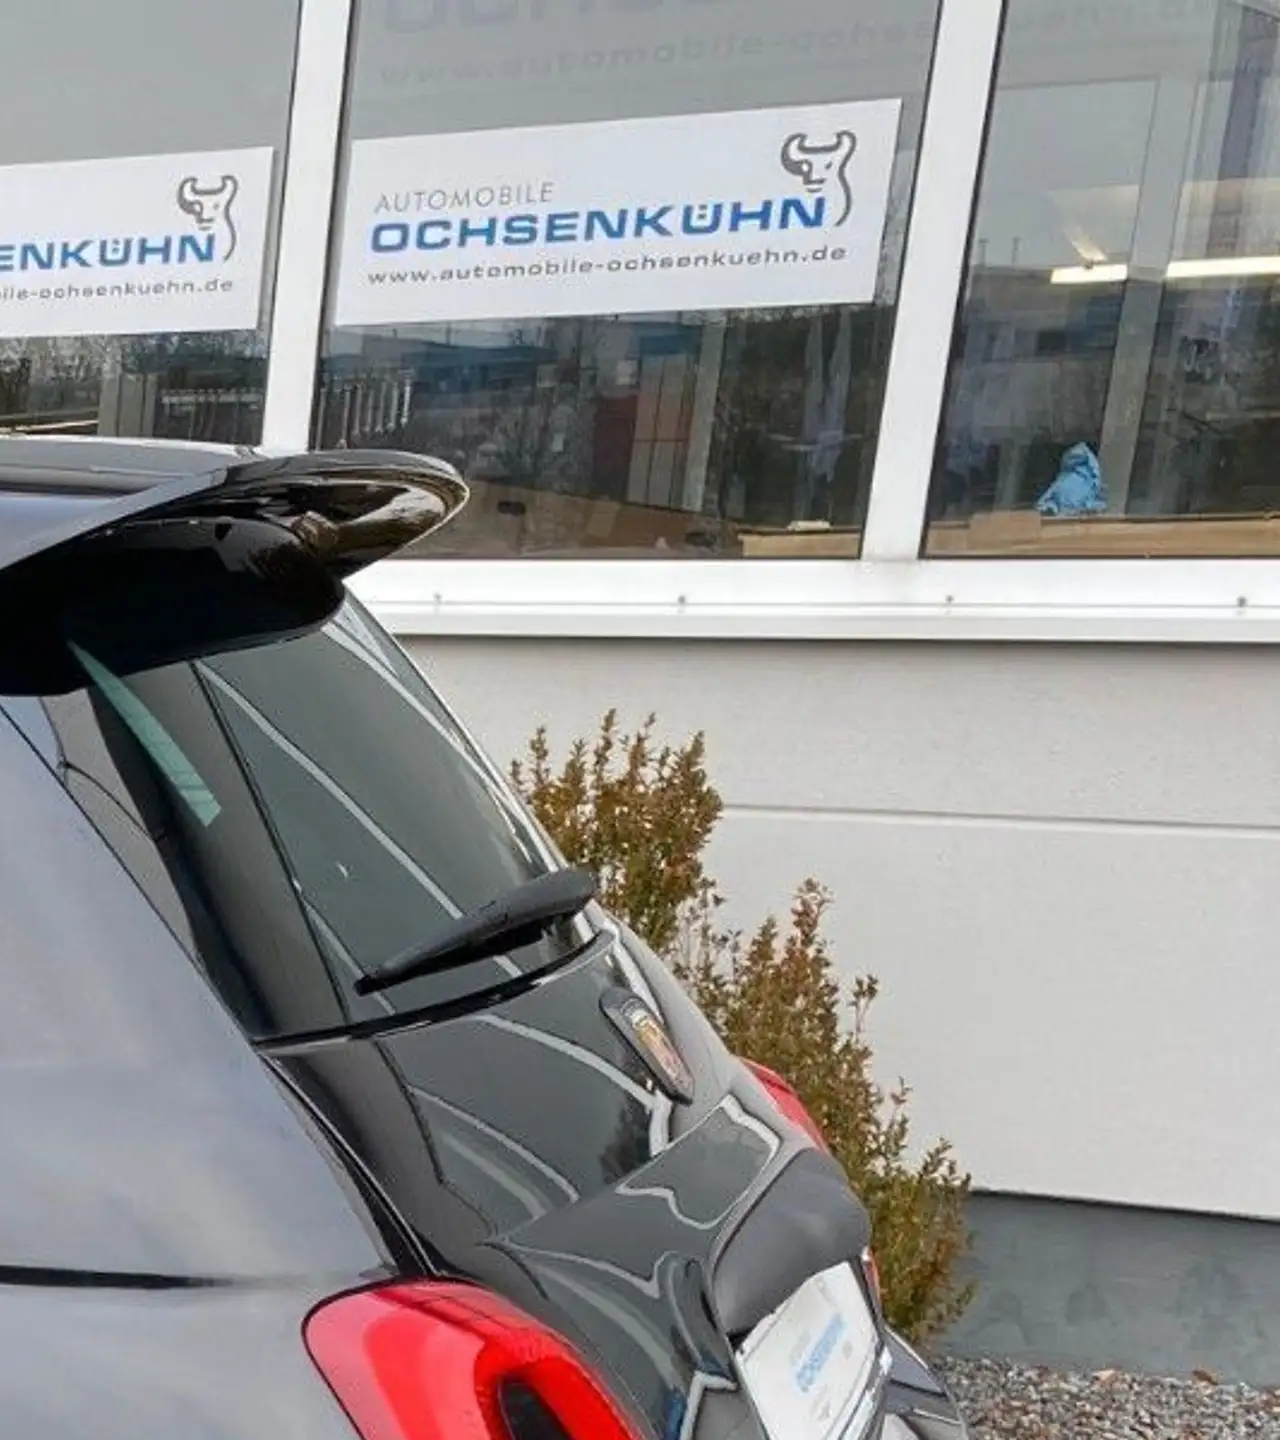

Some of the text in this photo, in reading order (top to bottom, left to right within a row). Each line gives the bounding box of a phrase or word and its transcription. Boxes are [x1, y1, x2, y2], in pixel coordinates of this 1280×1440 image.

[373, 182, 555, 214] AUTOMOBILE
[370, 196, 826, 254] OCHSENKÜHN
[366, 244, 847, 286] www.automobile-ochsenkuehn.de
